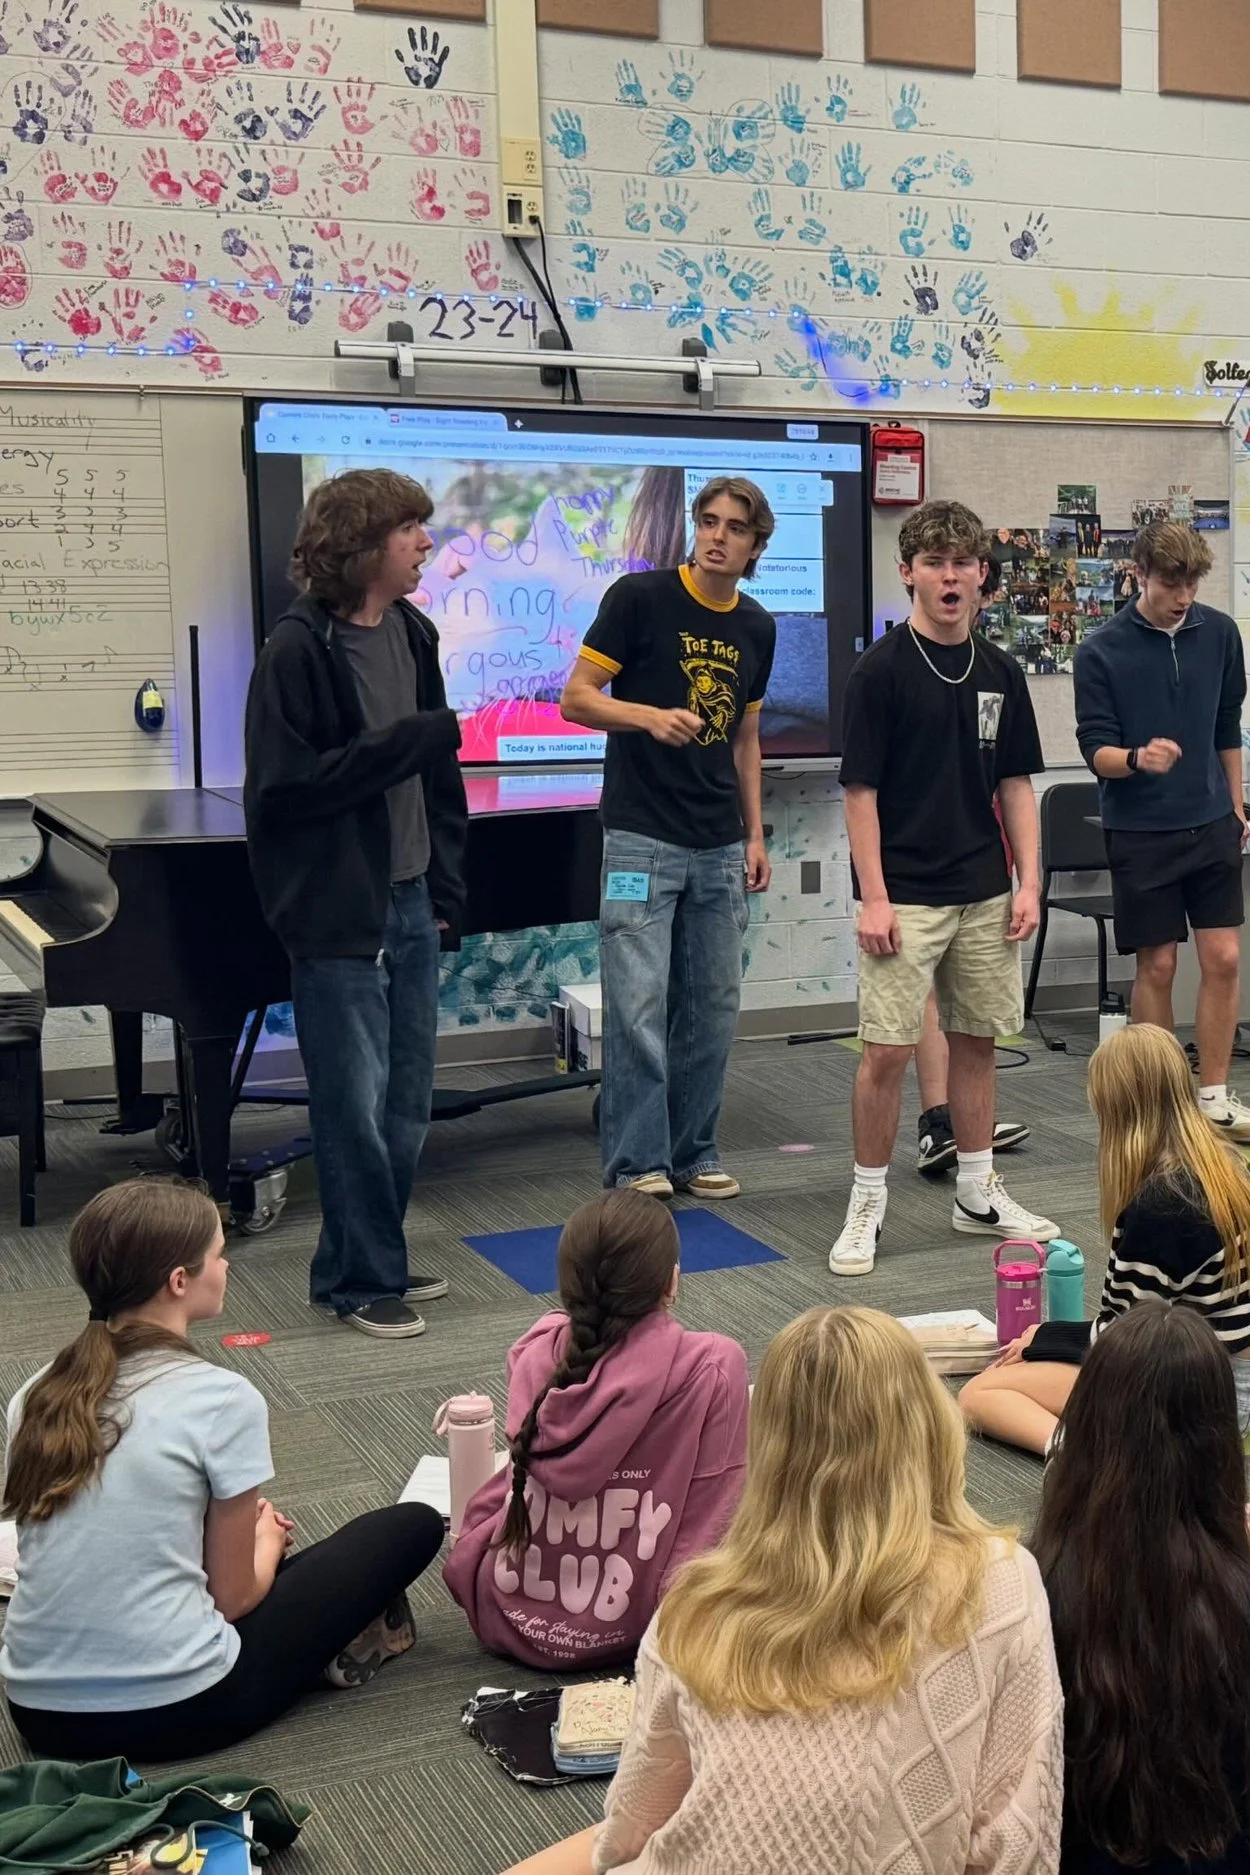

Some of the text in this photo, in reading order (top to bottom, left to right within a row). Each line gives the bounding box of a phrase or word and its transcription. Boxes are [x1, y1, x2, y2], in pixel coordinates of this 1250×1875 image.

[419, 297, 537, 339] 23-24
[55, 468, 130, 485] 5 5 5
[54, 488, 66, 504] 4
[84, 487, 95, 500] 4
[112, 487, 125, 503] 4
[55, 505, 66, 519] 3
[116, 506, 128, 520] 3
[0, 549, 170, 577] acial Expression
[682, 636, 740, 662] TOE TAGS
[505, 743, 534, 753] Today
[538, 743, 546, 752] is
[549, 742, 587, 751] national
[622, 1469, 651, 1479] ONLY
[494, 1544, 634, 1622] CLUB
[518, 1625, 626, 1649] YOUR OWN BLANKET
